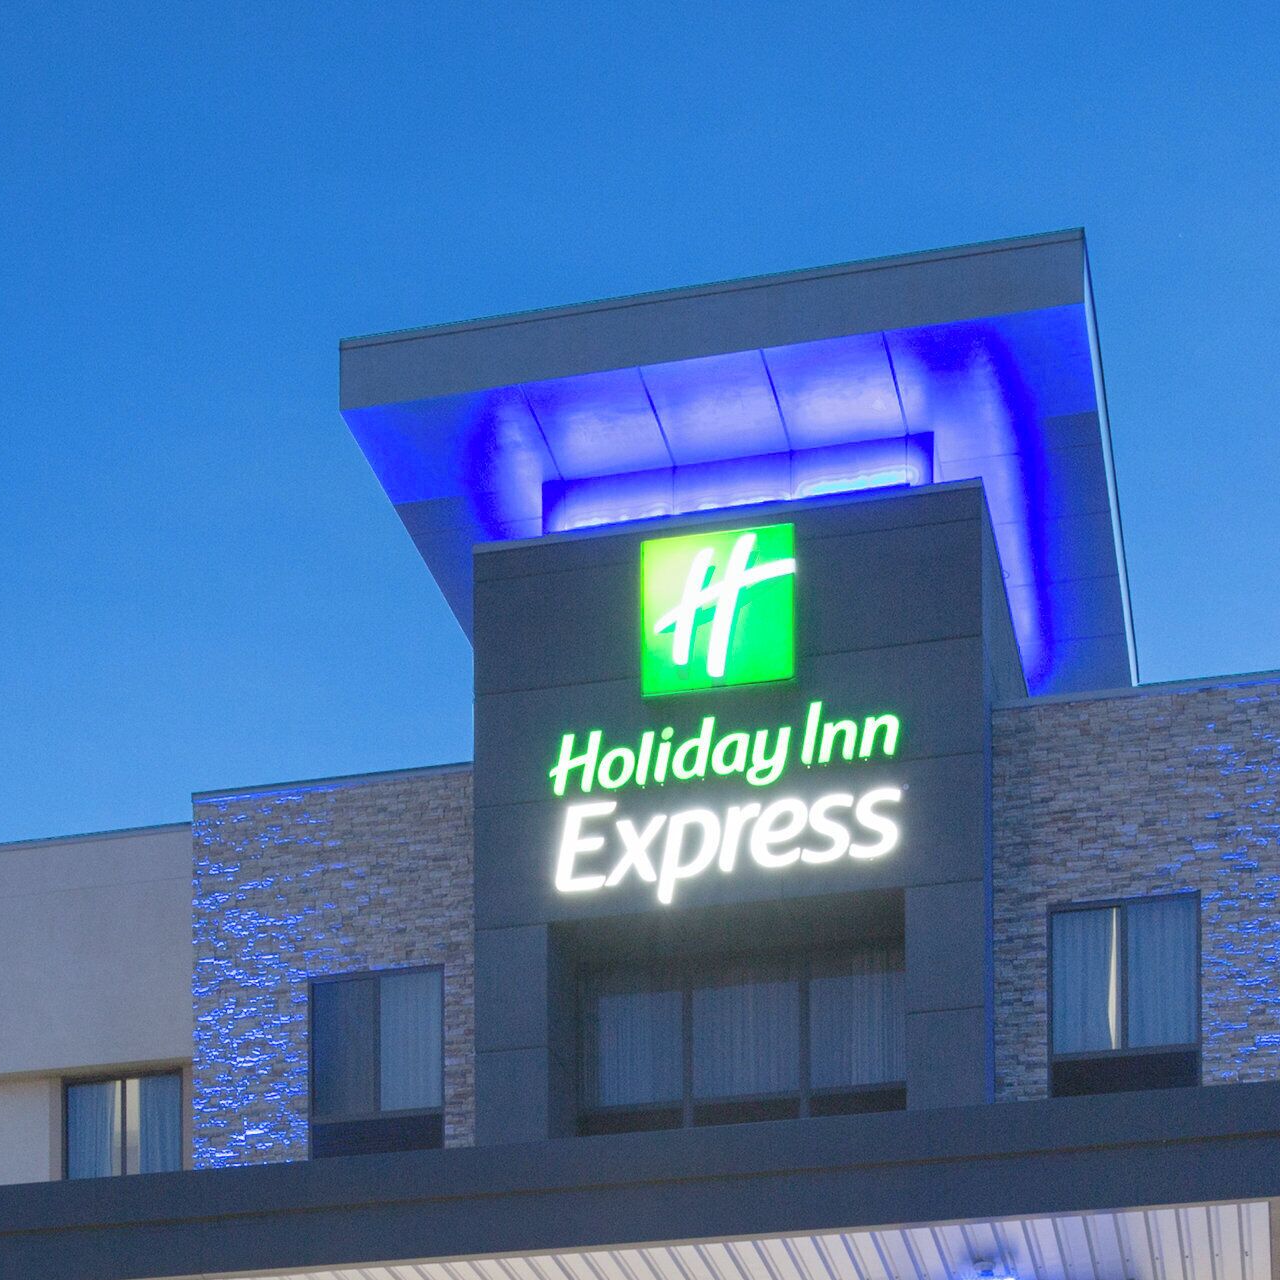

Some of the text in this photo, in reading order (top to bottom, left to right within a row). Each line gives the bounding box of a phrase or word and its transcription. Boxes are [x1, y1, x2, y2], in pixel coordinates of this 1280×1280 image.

[549, 701, 900, 796] Holiday Inn
[554, 788, 902, 904] Express
